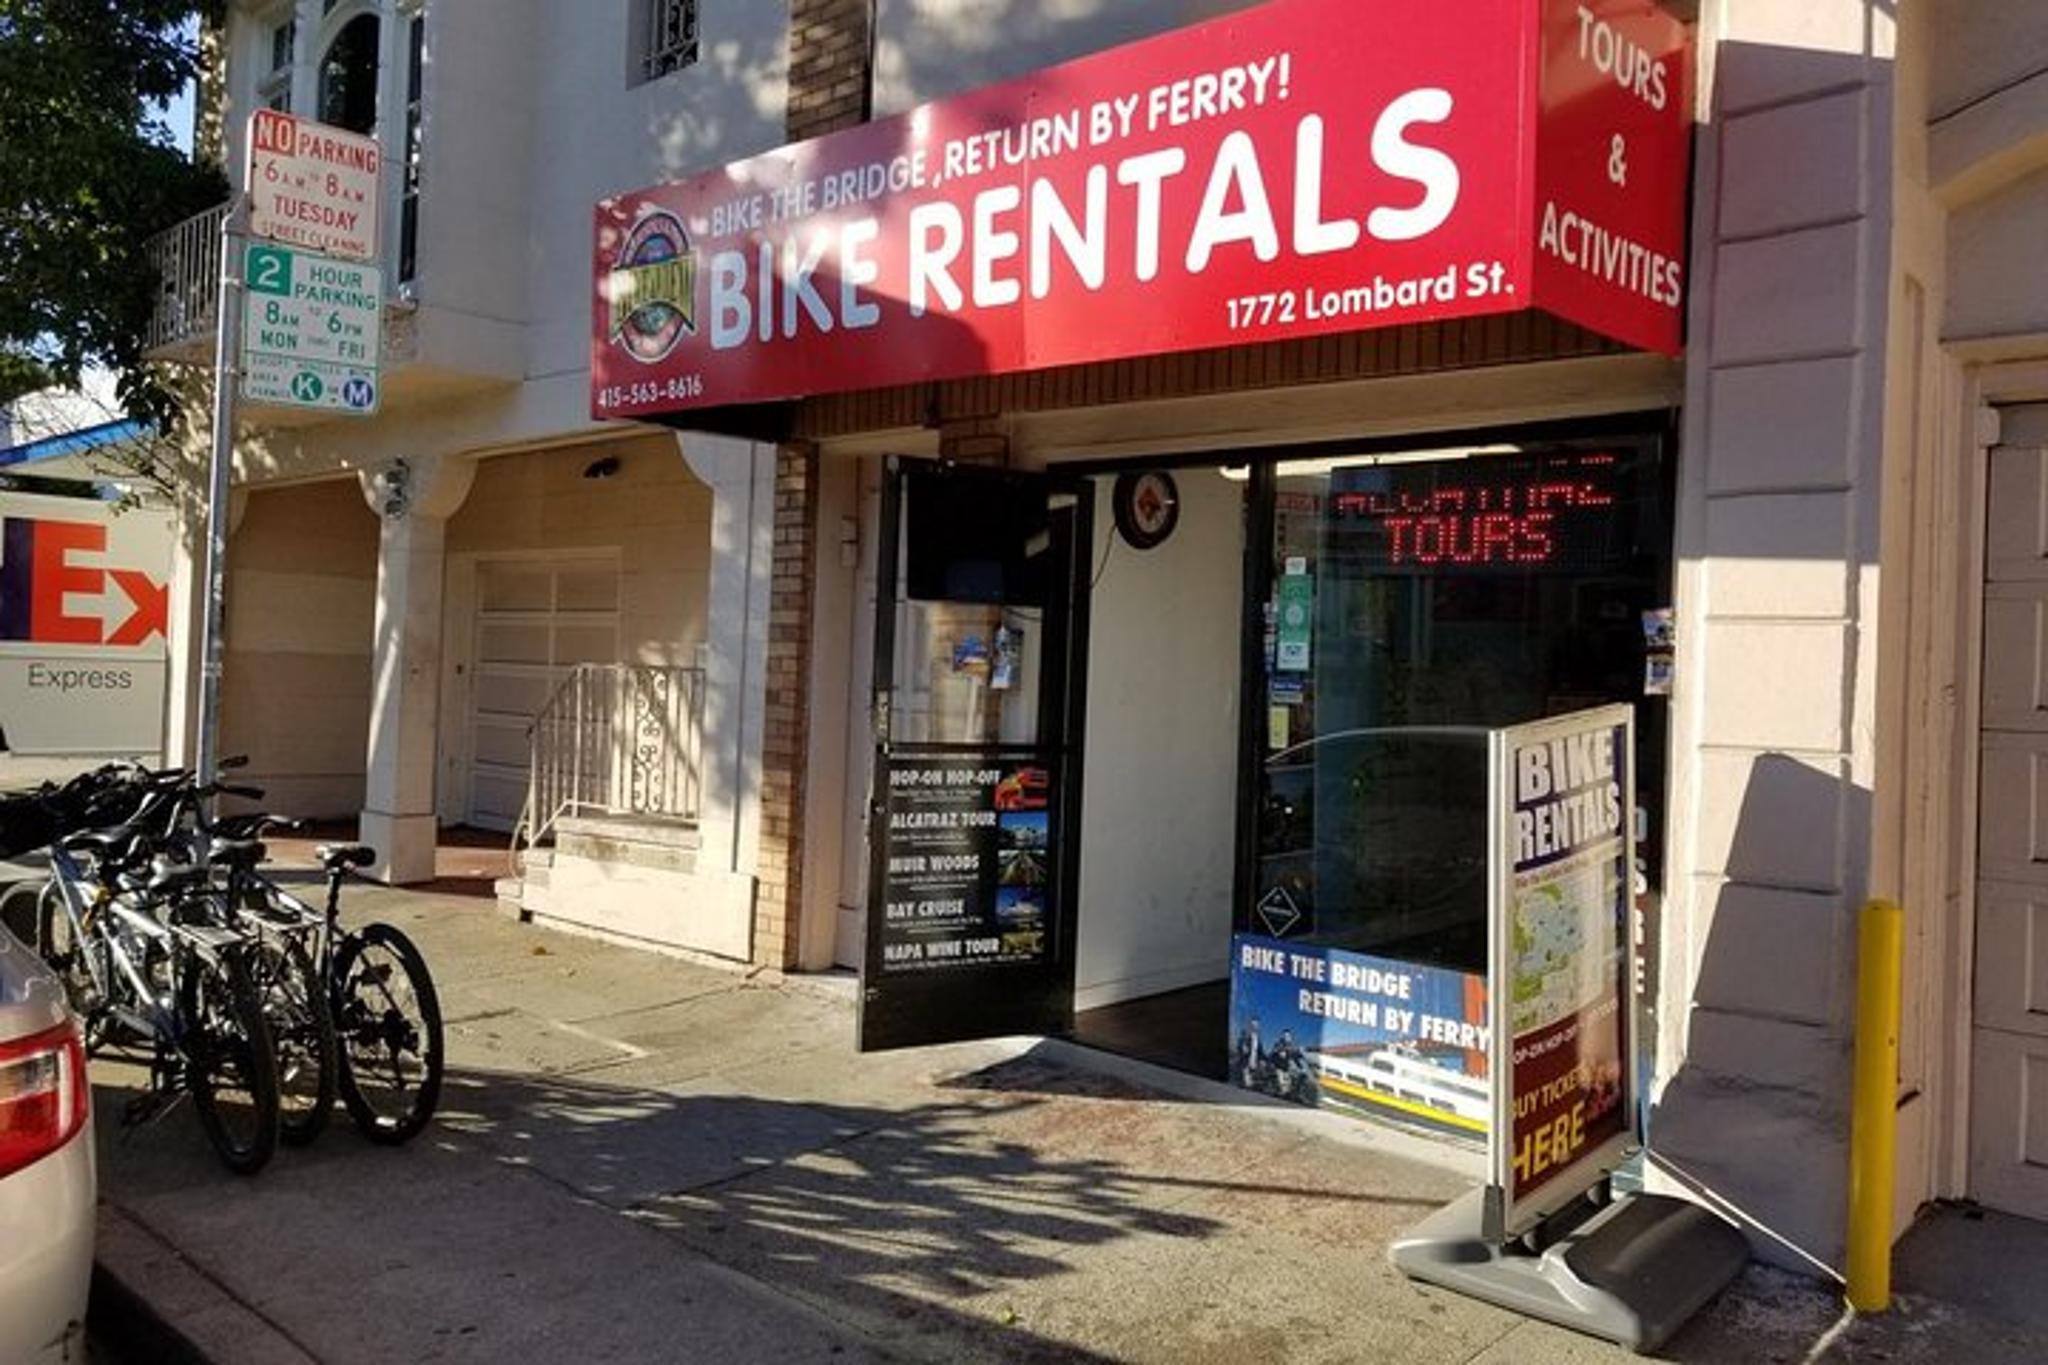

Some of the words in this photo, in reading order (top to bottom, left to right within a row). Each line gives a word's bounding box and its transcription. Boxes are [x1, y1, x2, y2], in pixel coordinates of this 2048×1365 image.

[1578, 5, 1667, 110] TOURS
[258, 113, 292, 152] NO
[299, 133, 377, 174] PARKING
[712, 197, 763, 237] BIKE
[770, 180, 816, 222] THE
[822, 155, 925, 213] BRIDGE
[1089, 93, 1139, 146] BY
[1147, 53, 1292, 131] FERRY!
[1608, 133, 1627, 187] &
[274, 194, 358, 232] TUESDAY
[709, 216, 881, 350] BIKE
[908, 87, 1460, 318] RENTALS
[258, 255, 280, 288] 2
[309, 264, 363, 288] HOUR
[1539, 202, 1681, 307] ACTIVITIES
[294, 282, 376, 311] PARKING
[1226, 293, 1296, 329] 1772
[1304, 268, 1457, 321] Lombard
[1465, 261, 1514, 297] St.
[261, 329, 297, 349] MON
[338, 341, 365, 360] FRI
[598, 374, 703, 408] 415-563-8616
[1384, 513, 1554, 564] TOURS
[27, 664, 132, 692] Express
[1517, 728, 1614, 803] BIKE
[889, 813, 957, 829] ALCATRAZ
[961, 811, 997, 827] TOUR
[1513, 781, 1621, 864] RENTALS
[888, 856, 926, 872] MUIR
[929, 855, 980, 870] WOODS
[886, 902, 915, 920] BAY
[917, 900, 965, 917] CRUISE
[884, 943, 923, 960] NAPA
[926, 940, 962, 957] WINE
[965, 938, 1000, 954] TOUR
[1241, 945, 1286, 974] BIKE
[1290, 955, 1325, 982] THE
[1330, 962, 1412, 1000] BRIDGE
[1299, 989, 1378, 1028] RETURN
[1385, 1006, 1415, 1034] BY
[1421, 1014, 1490, 1052] FERRY
[1510, 1099, 1586, 1181] HERE
